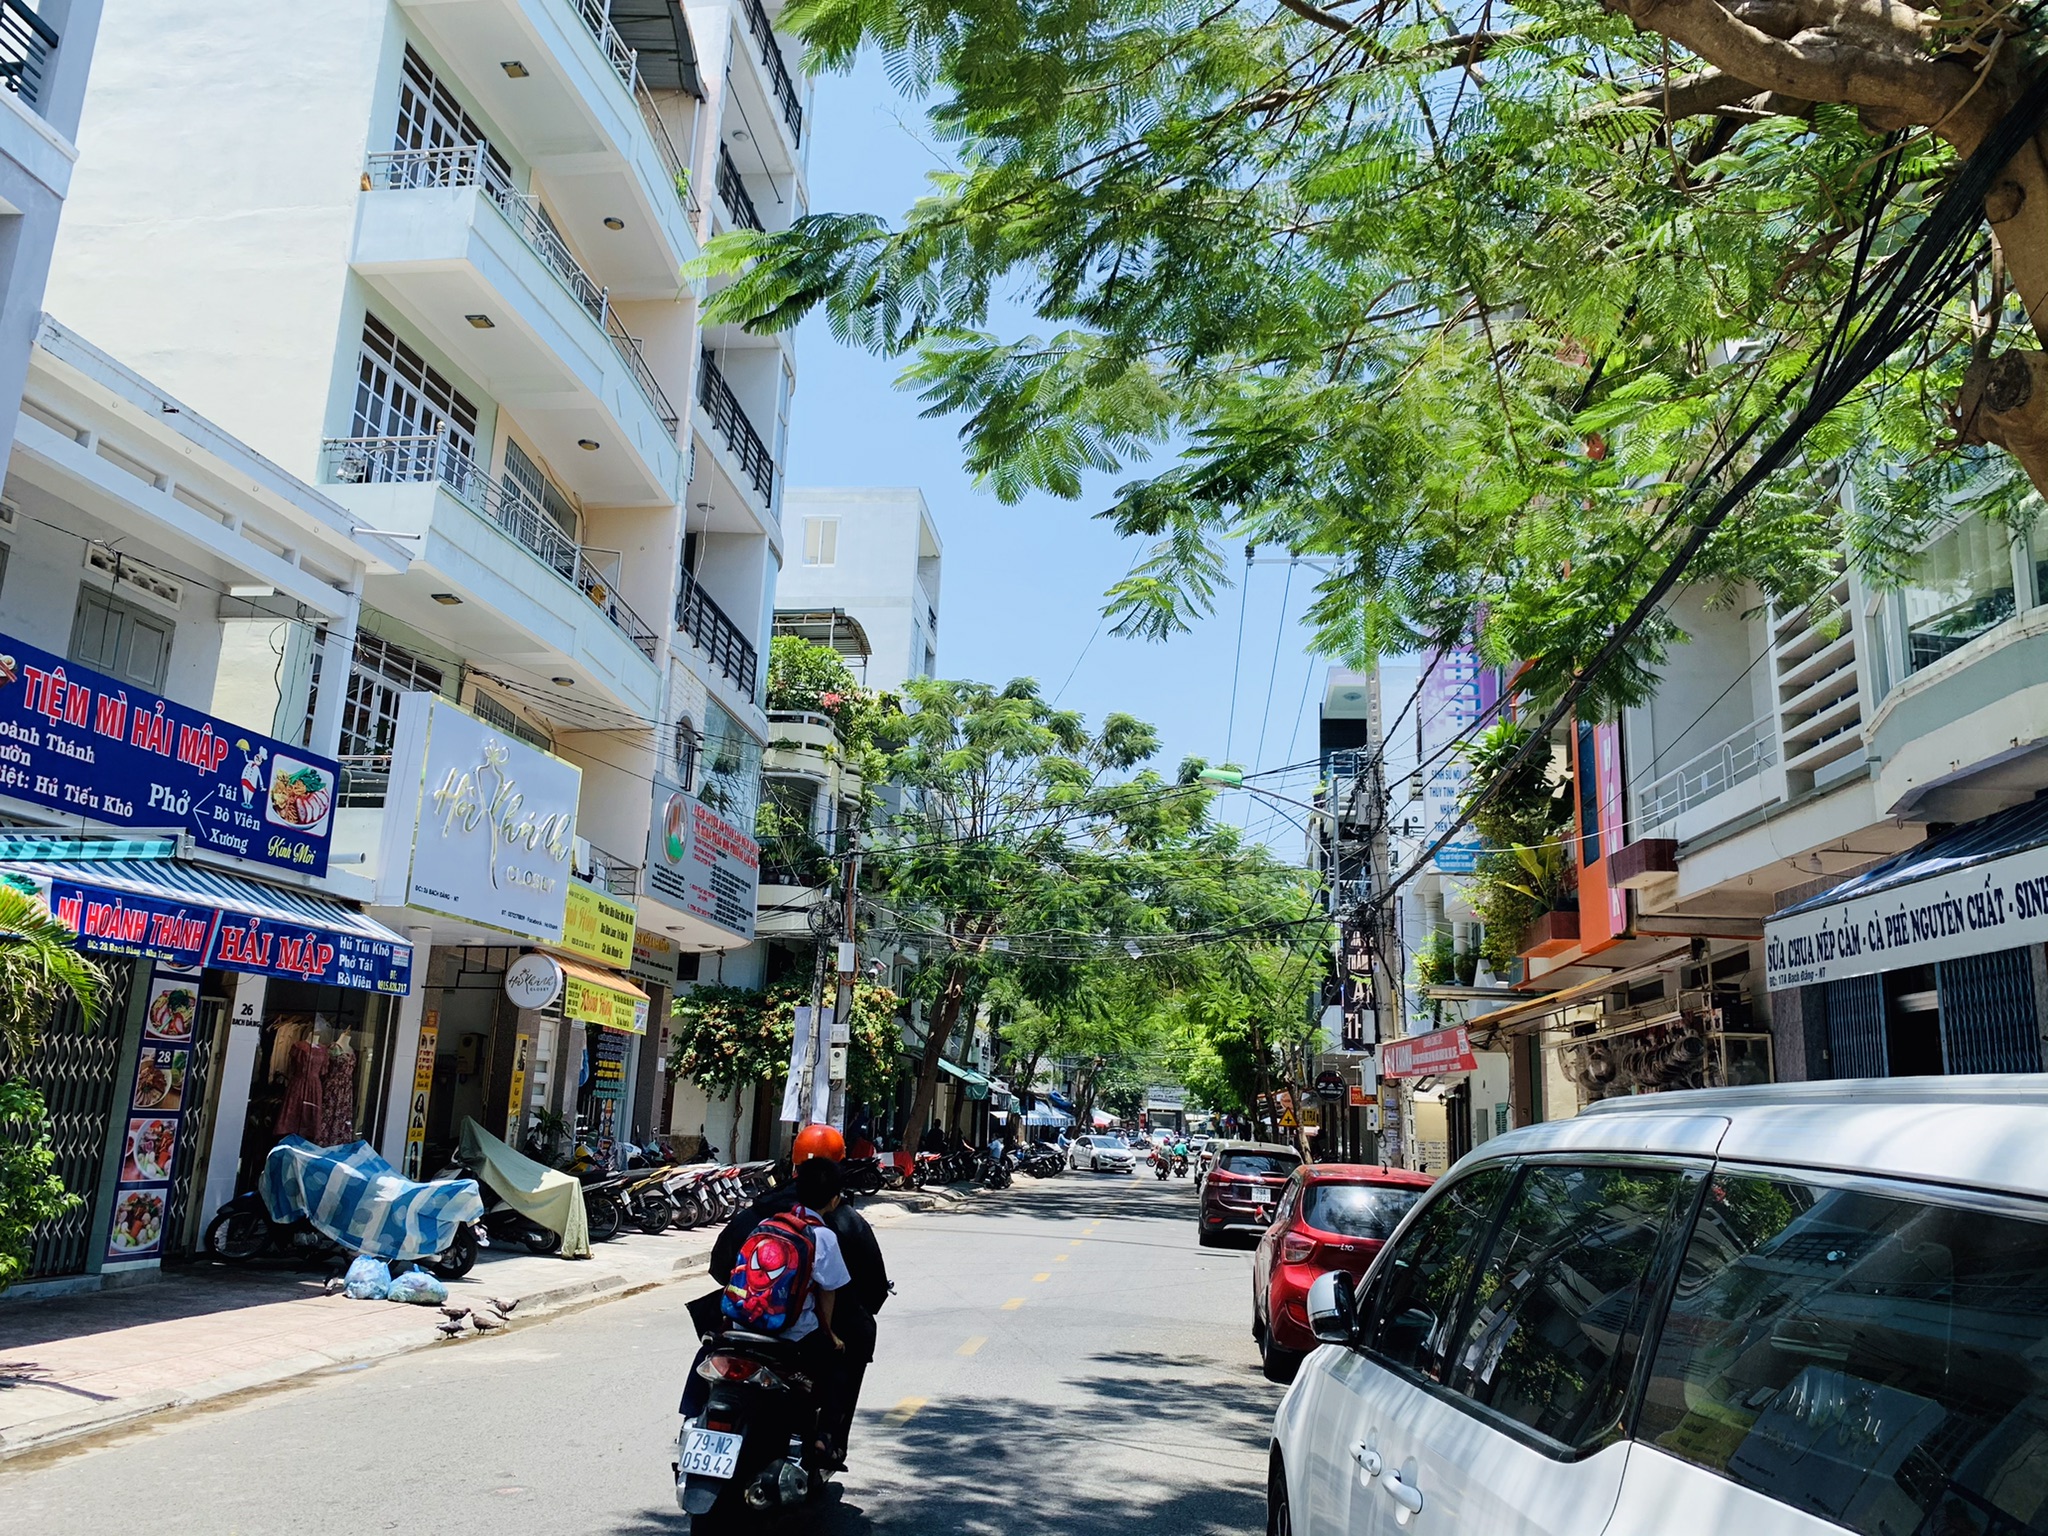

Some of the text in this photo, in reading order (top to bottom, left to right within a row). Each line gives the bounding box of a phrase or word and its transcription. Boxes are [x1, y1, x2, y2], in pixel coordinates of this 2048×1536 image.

[24, 665, 229, 776] TIỆM MÌ HẢI MẬP
[0, 720, 95, 764] oành Thánh
[0, 744, 31, 767] ườn
[0, 764, 133, 818] iệt: Hủ Tiếu Khô
[147, 783, 191, 815] Phở
[217, 783, 238, 801] Tái
[213, 805, 261, 831] Bò Viên
[209, 828, 249, 854] Xương
[57, 890, 206, 951] MÌ HOÀNH THÁNH
[1767, 935, 1786, 972] SỮA
[1788, 935, 1815, 968] CHUA
[1815, 916, 1836, 962] NẾP
[1837, 907, 1861, 959] CẨM
[1868, 909, 1885, 952] CÀ
[1885, 902, 1910, 948] PHÊ
[1910, 890, 1965, 943] NGUYÊN
[1967, 873, 2005, 930] CHẤT
[217, 917, 274, 967] HẢI
[275, 932, 334, 981] MẬP
[340, 936, 352, 950] Hủ
[355, 939, 370, 953] Tíu
[372, 942, 390, 957] Khô
[338, 954, 374, 972] Phở Tái
[337, 971, 372, 989] Bò Viên
[240, 1003, 253, 1016] 26
[682, 1451, 733, 1476] 059.42
